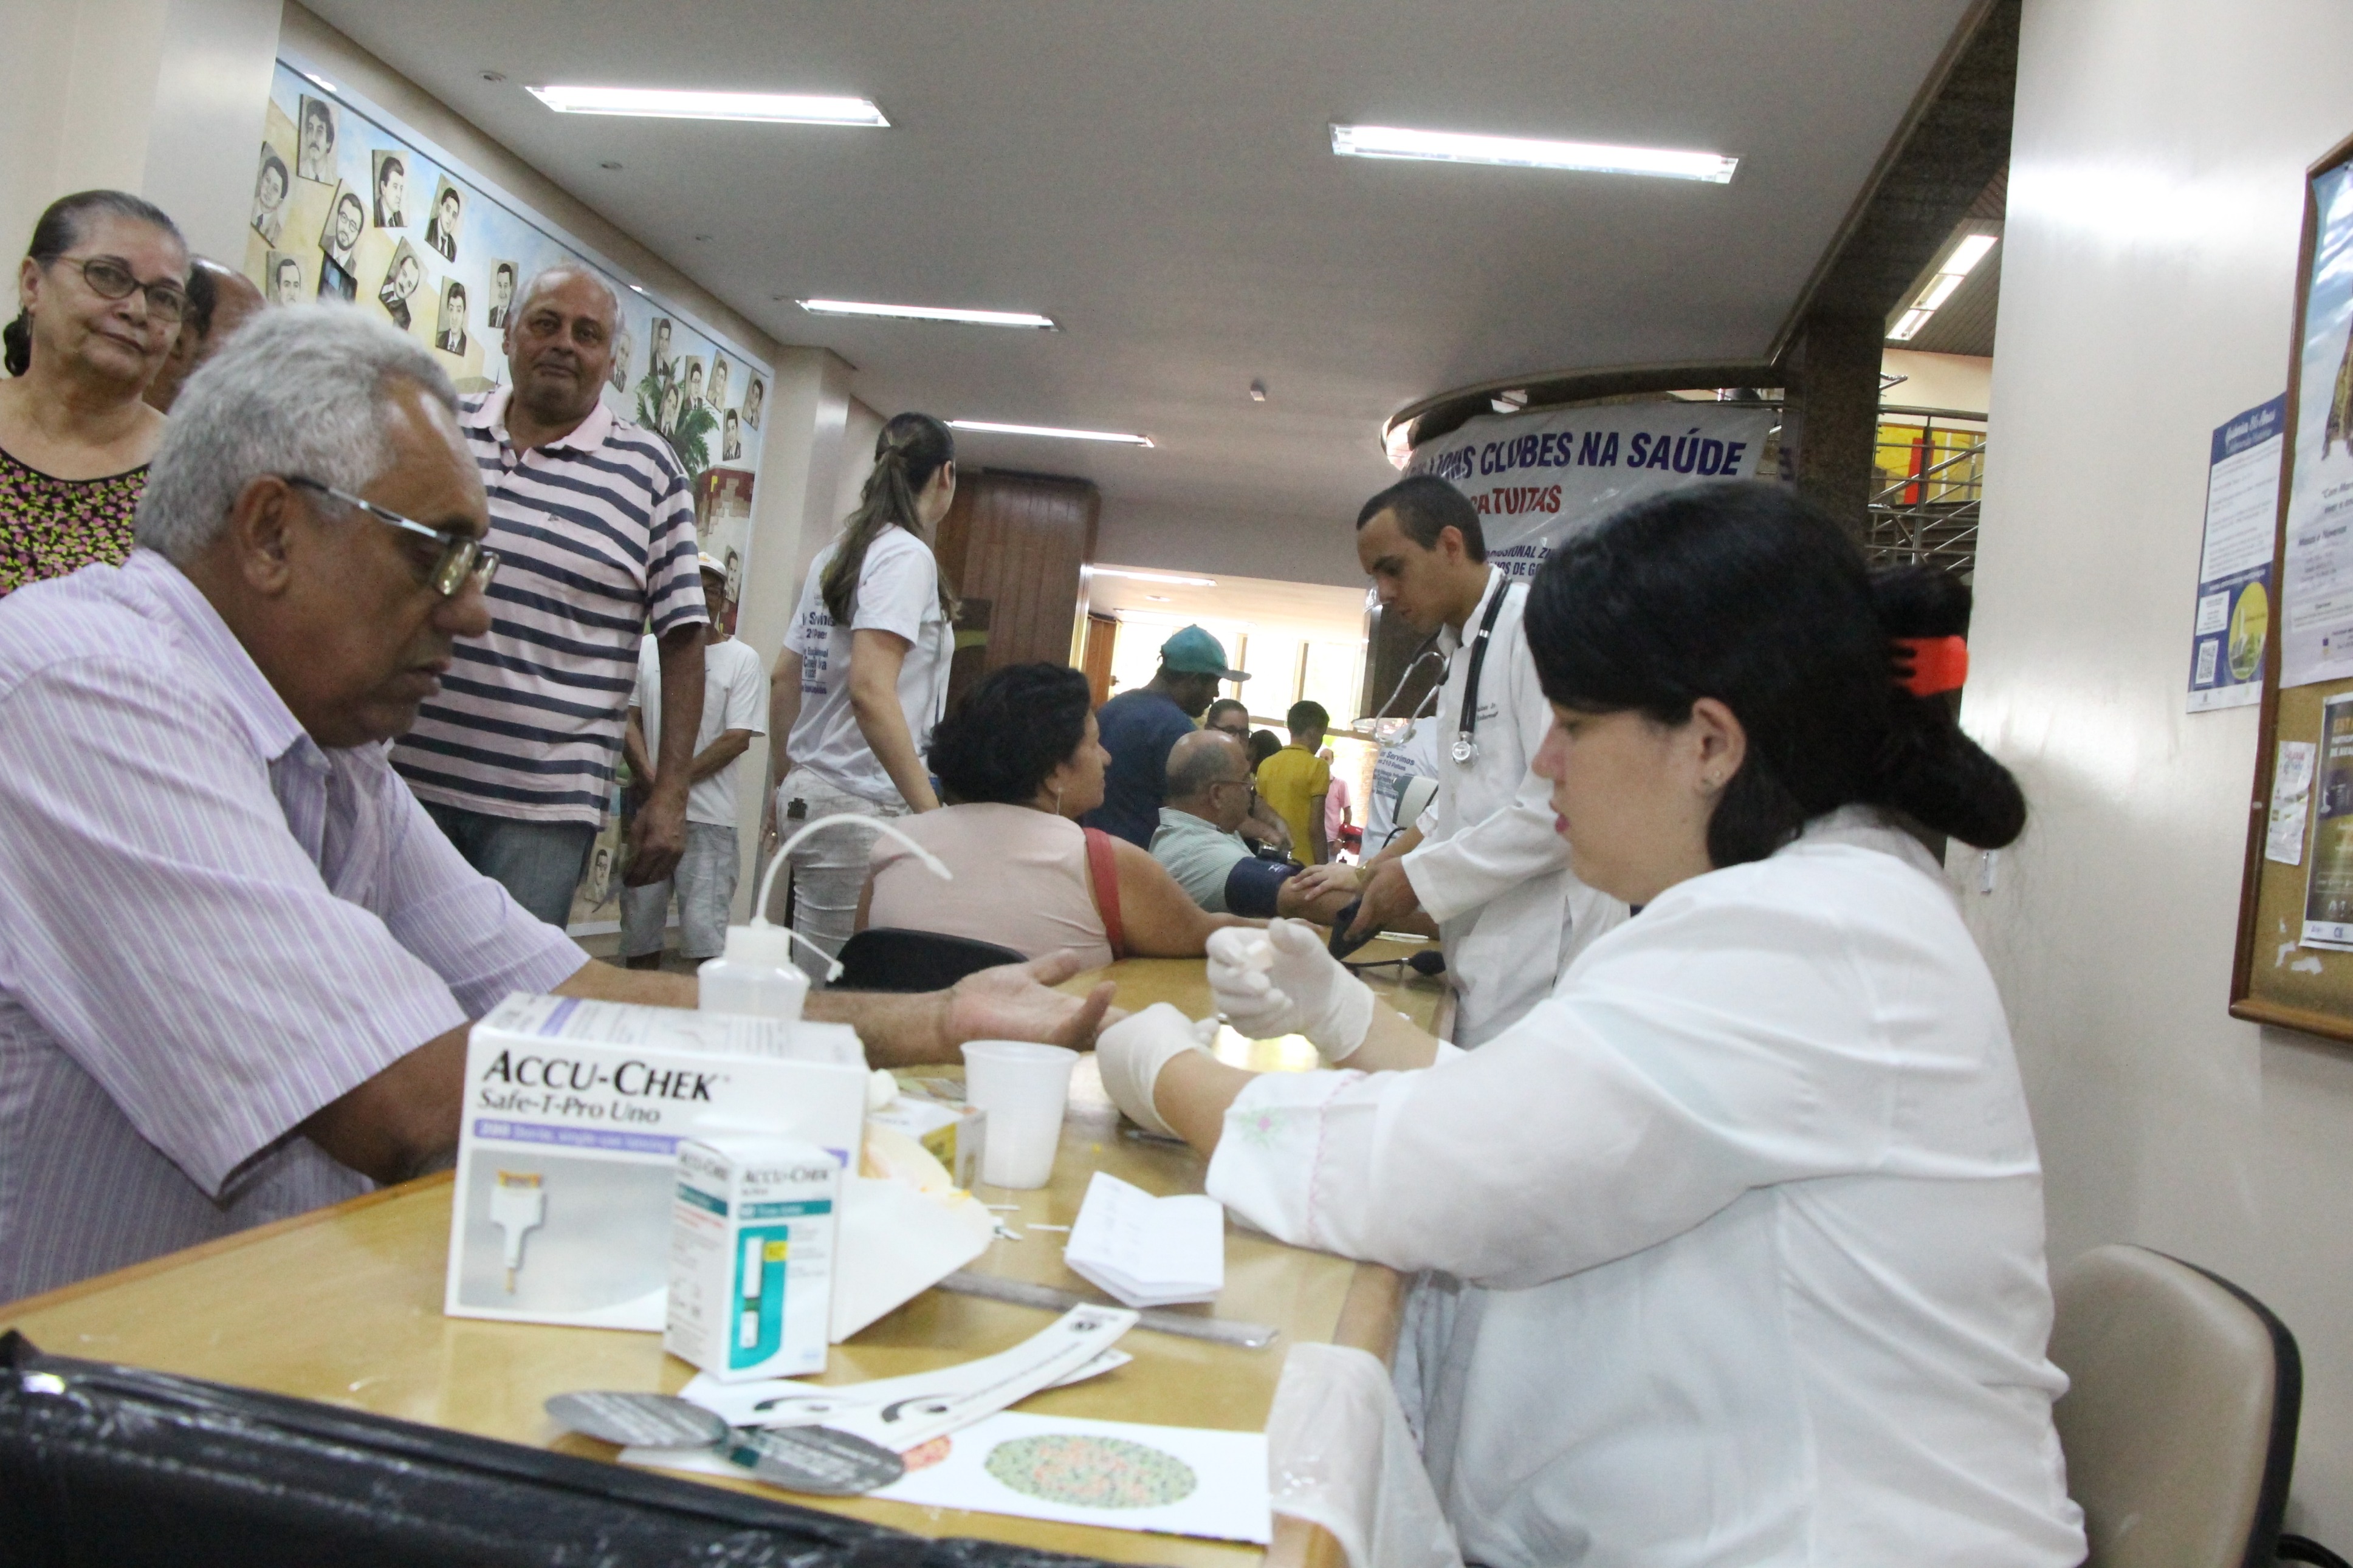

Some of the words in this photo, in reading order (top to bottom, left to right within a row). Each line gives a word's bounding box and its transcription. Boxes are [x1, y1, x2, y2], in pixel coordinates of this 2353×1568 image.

[1480, 431, 1573, 476] CLUBES
[1577, 431, 1619, 467] NA
[1627, 428, 1747, 476] SAÚDE
[1513, 562, 1527, 575] DE
[482, 1049, 719, 1103] ACCU-CHEK
[478, 1087, 605, 1119] Safe-T-Pro
[610, 1100, 662, 1124] Uno
